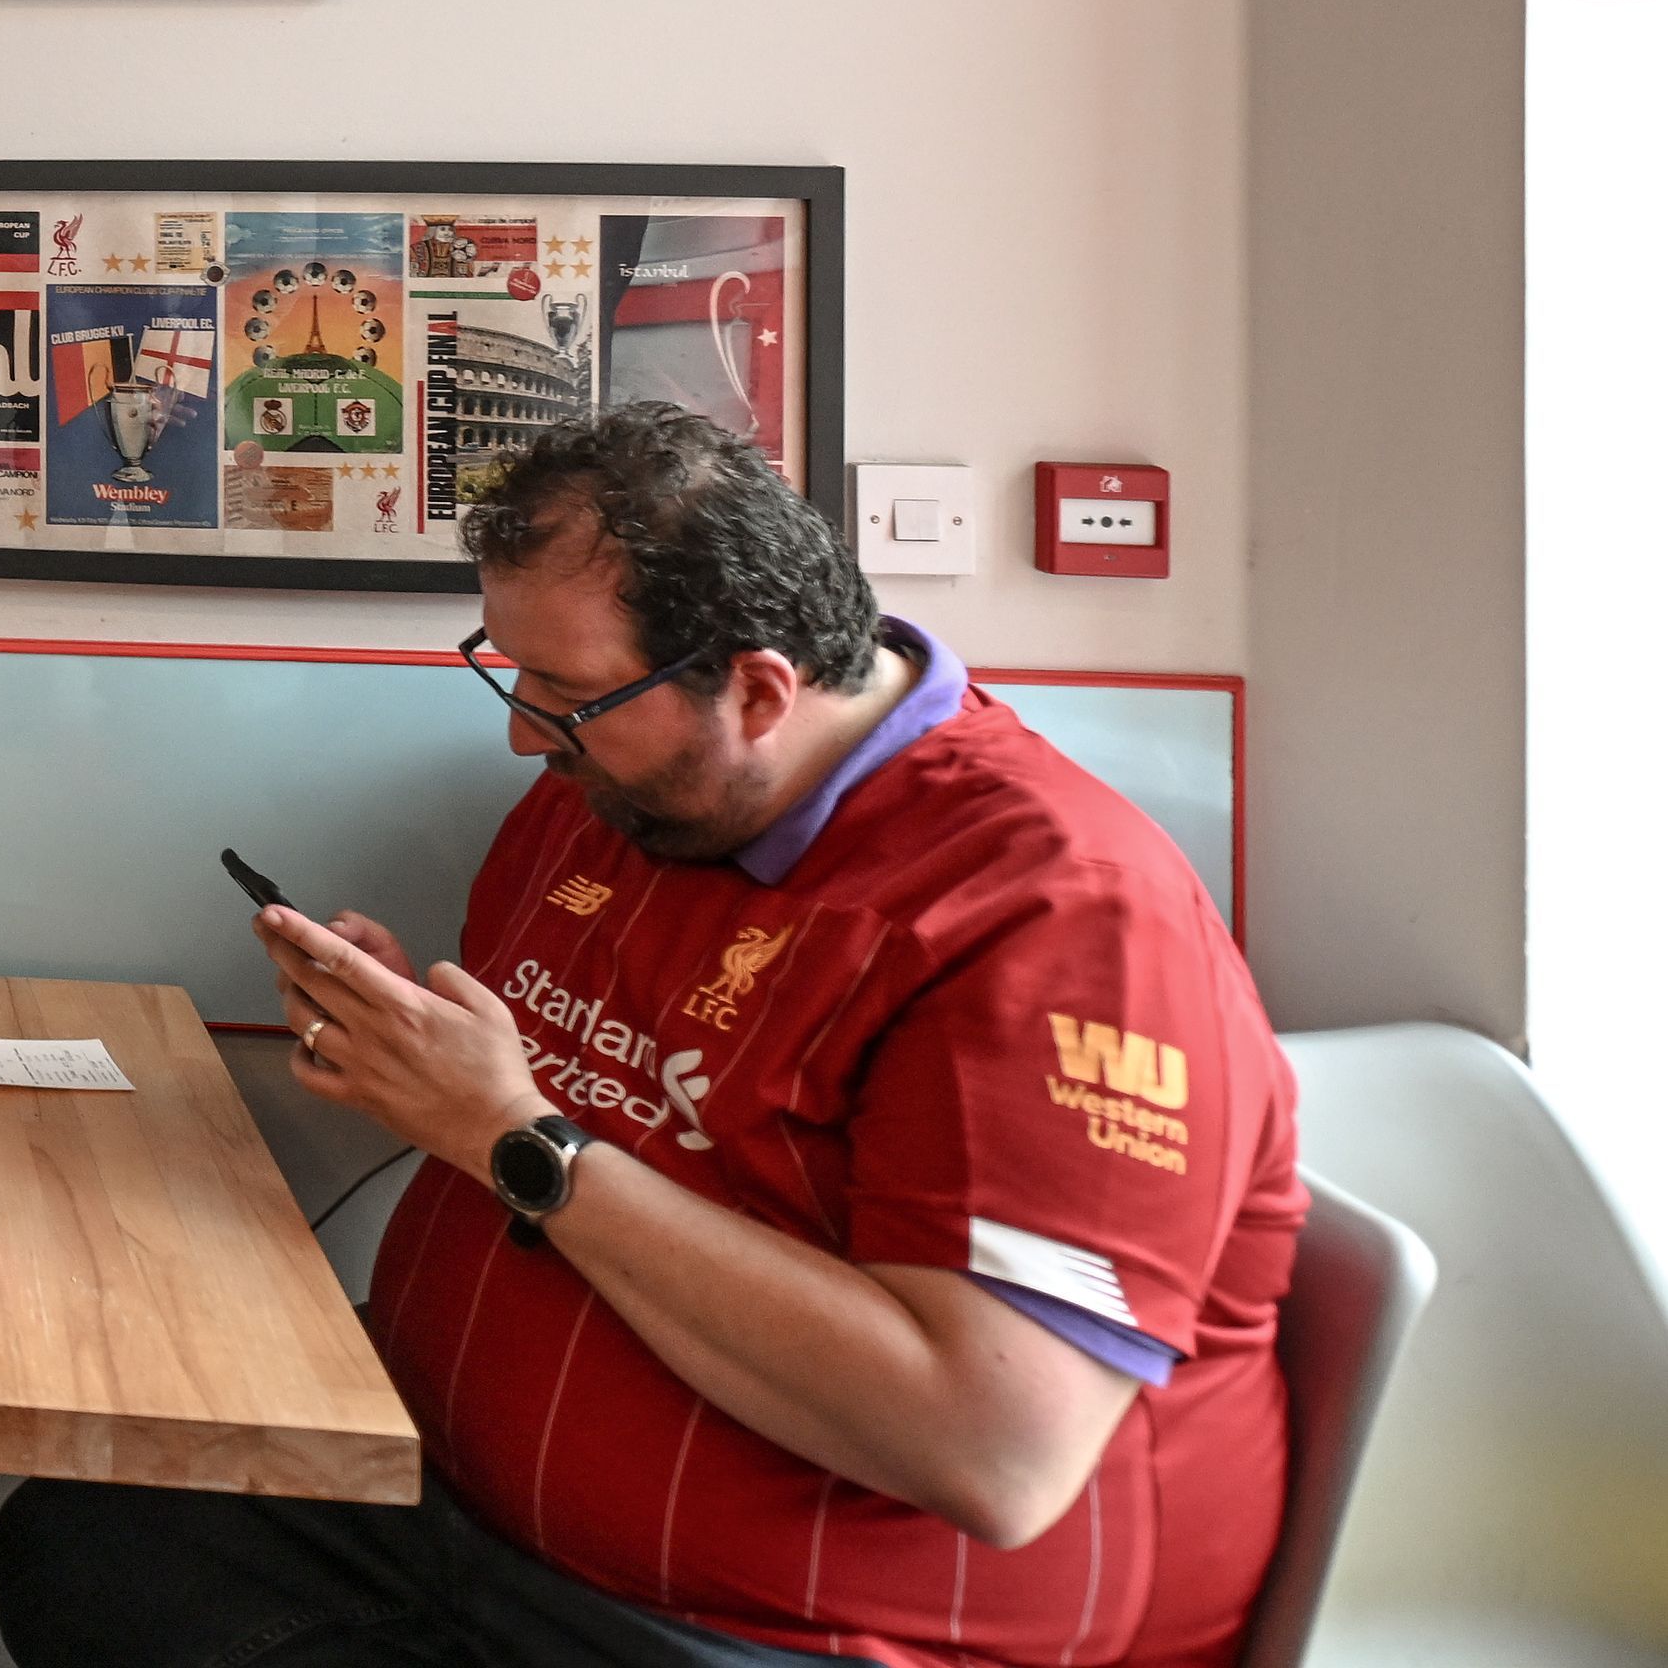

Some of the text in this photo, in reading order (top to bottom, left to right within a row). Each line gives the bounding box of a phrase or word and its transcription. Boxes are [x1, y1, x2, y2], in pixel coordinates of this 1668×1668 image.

[151, 317, 199, 329] LIVERPOOL
[50, 324, 125, 345] CLUB BRUGGE KV
[278, 382, 330, 393] LIVERPOOL
[427, 310, 458, 520] EUROPEAN CUP FINAL
[11, 488, 35, 496] NORD
[92, 483, 172, 505] Wembley
[110, 501, 151, 513] Stadium
[1047, 1011, 1189, 1110] WU
[1044, 1074, 1189, 1145] Western
[1086, 1114, 1188, 1176] Union
